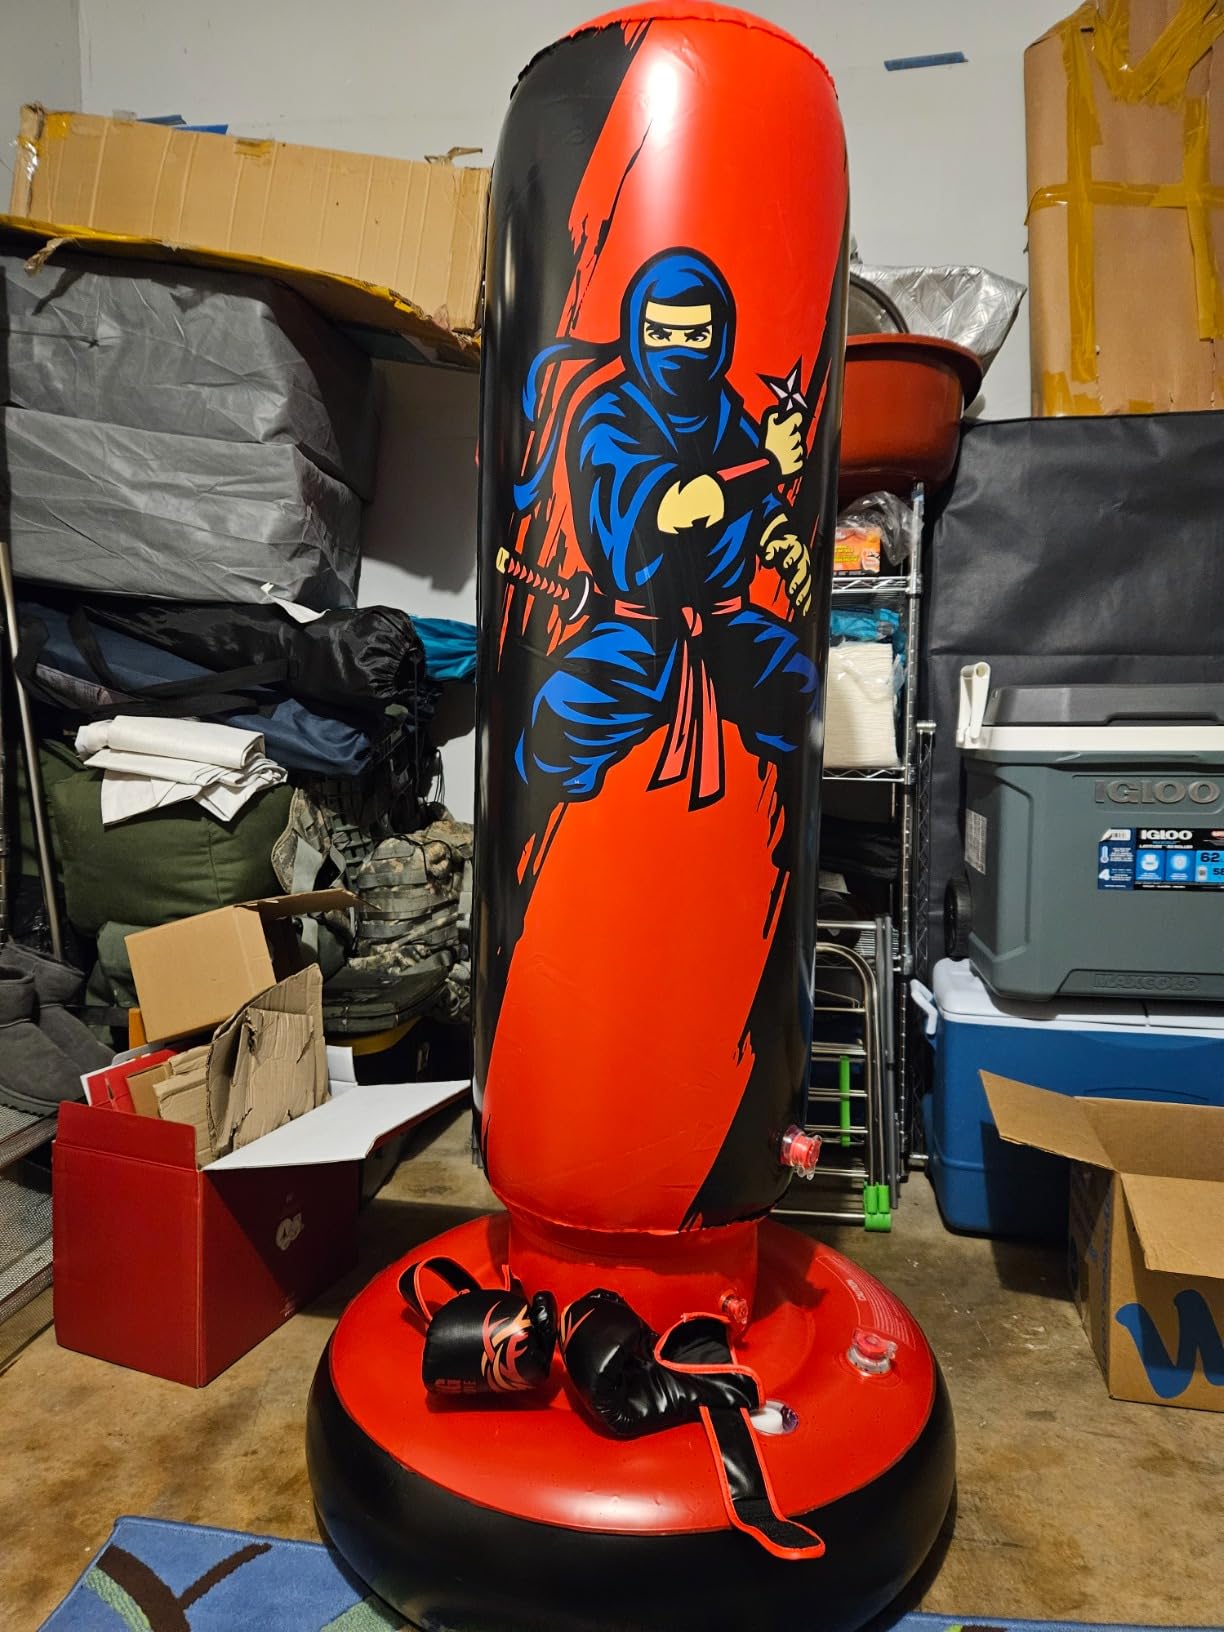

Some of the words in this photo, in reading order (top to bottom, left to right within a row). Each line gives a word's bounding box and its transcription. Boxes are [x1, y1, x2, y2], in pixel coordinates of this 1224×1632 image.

[1095, 780, 1220, 804] IGLOO
[1140, 829, 1193, 840] IGLOO
[1200, 852, 1220, 863] 62
[1099, 868, 1110, 881] 4
